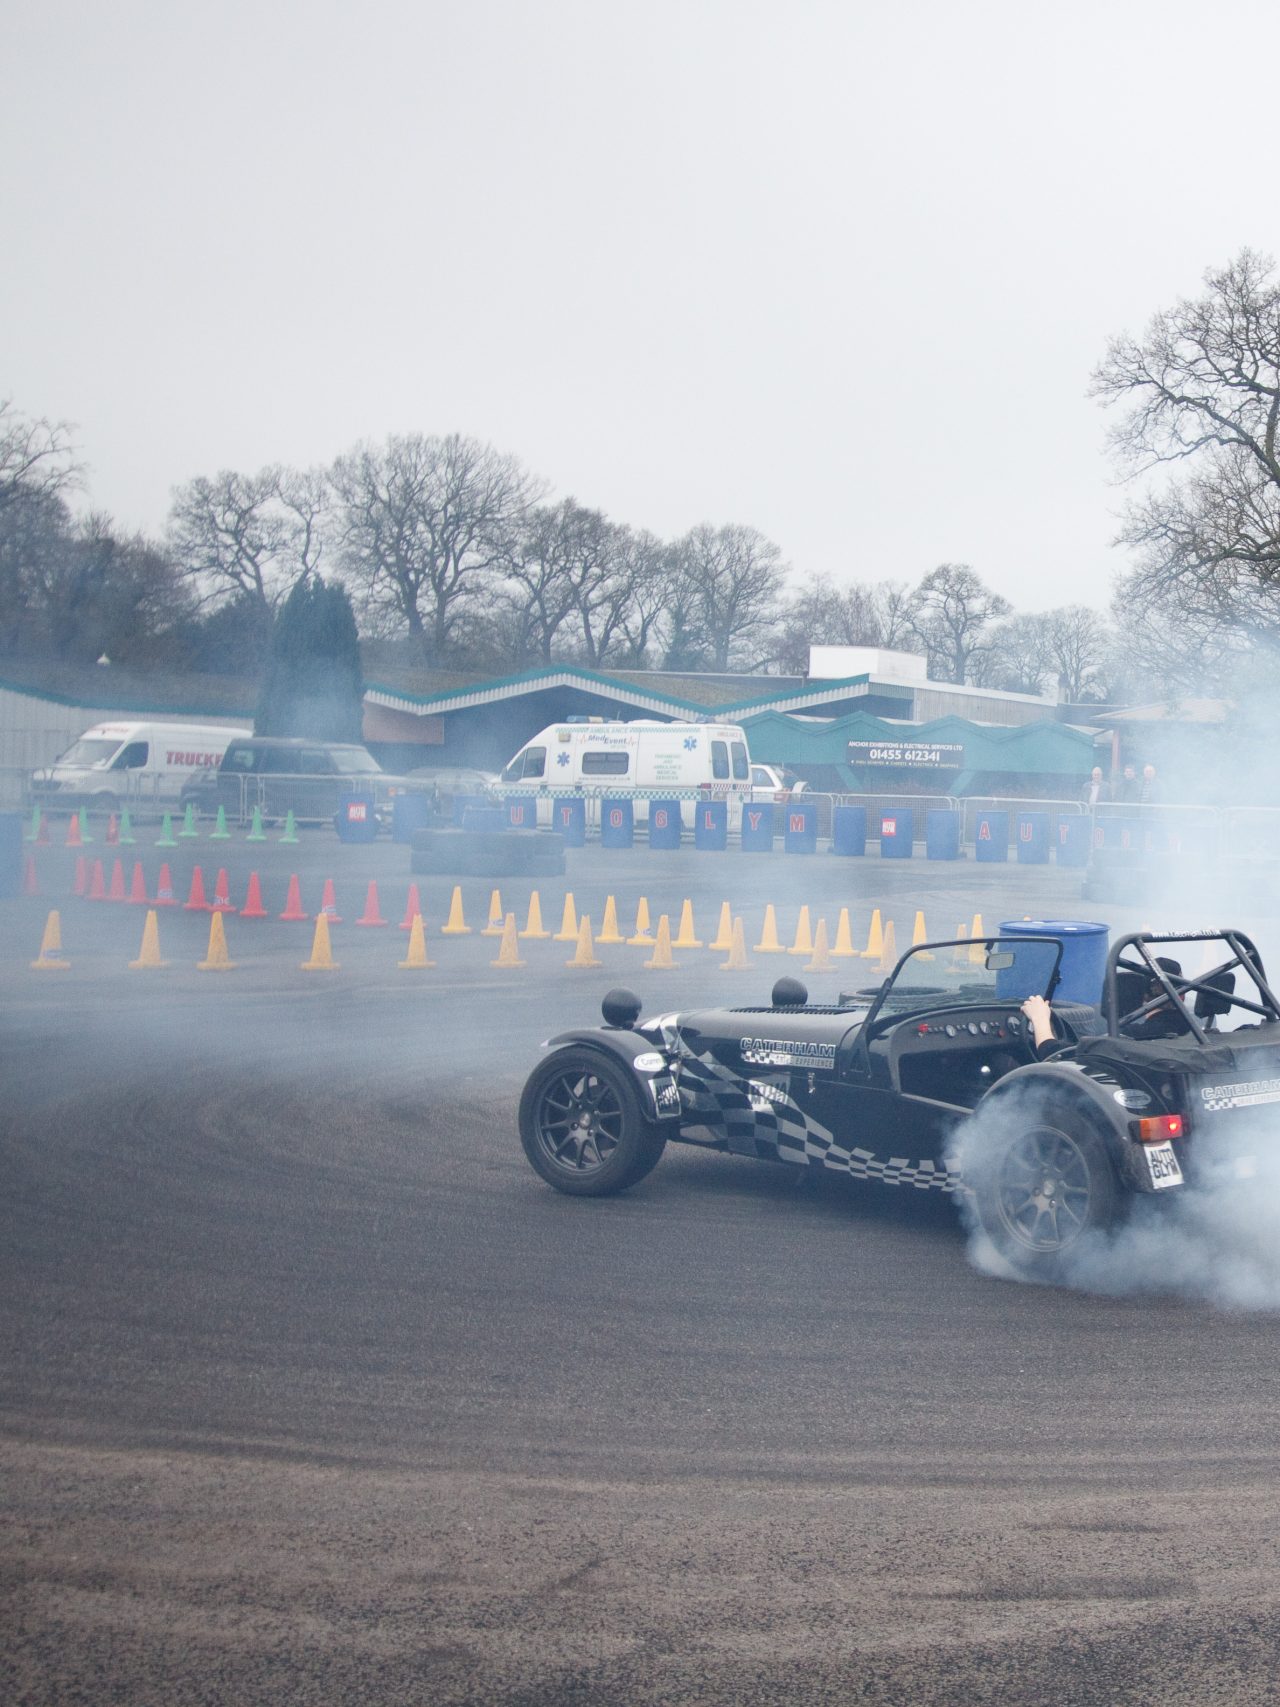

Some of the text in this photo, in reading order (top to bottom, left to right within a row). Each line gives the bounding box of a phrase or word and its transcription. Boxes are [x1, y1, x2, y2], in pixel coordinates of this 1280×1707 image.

[848, 740, 869, 748] ANCHOR
[869, 748, 940, 761] 01455 612341
[511, 807, 524, 825] U
[561, 808, 572, 826] T
[704, 811, 716, 829] L
[749, 812, 762, 831] Y
[790, 814, 805, 833] M
[741, 1037, 836, 1057] CATERHAM
[795, 1056, 833, 1068] EXPERIENCE
